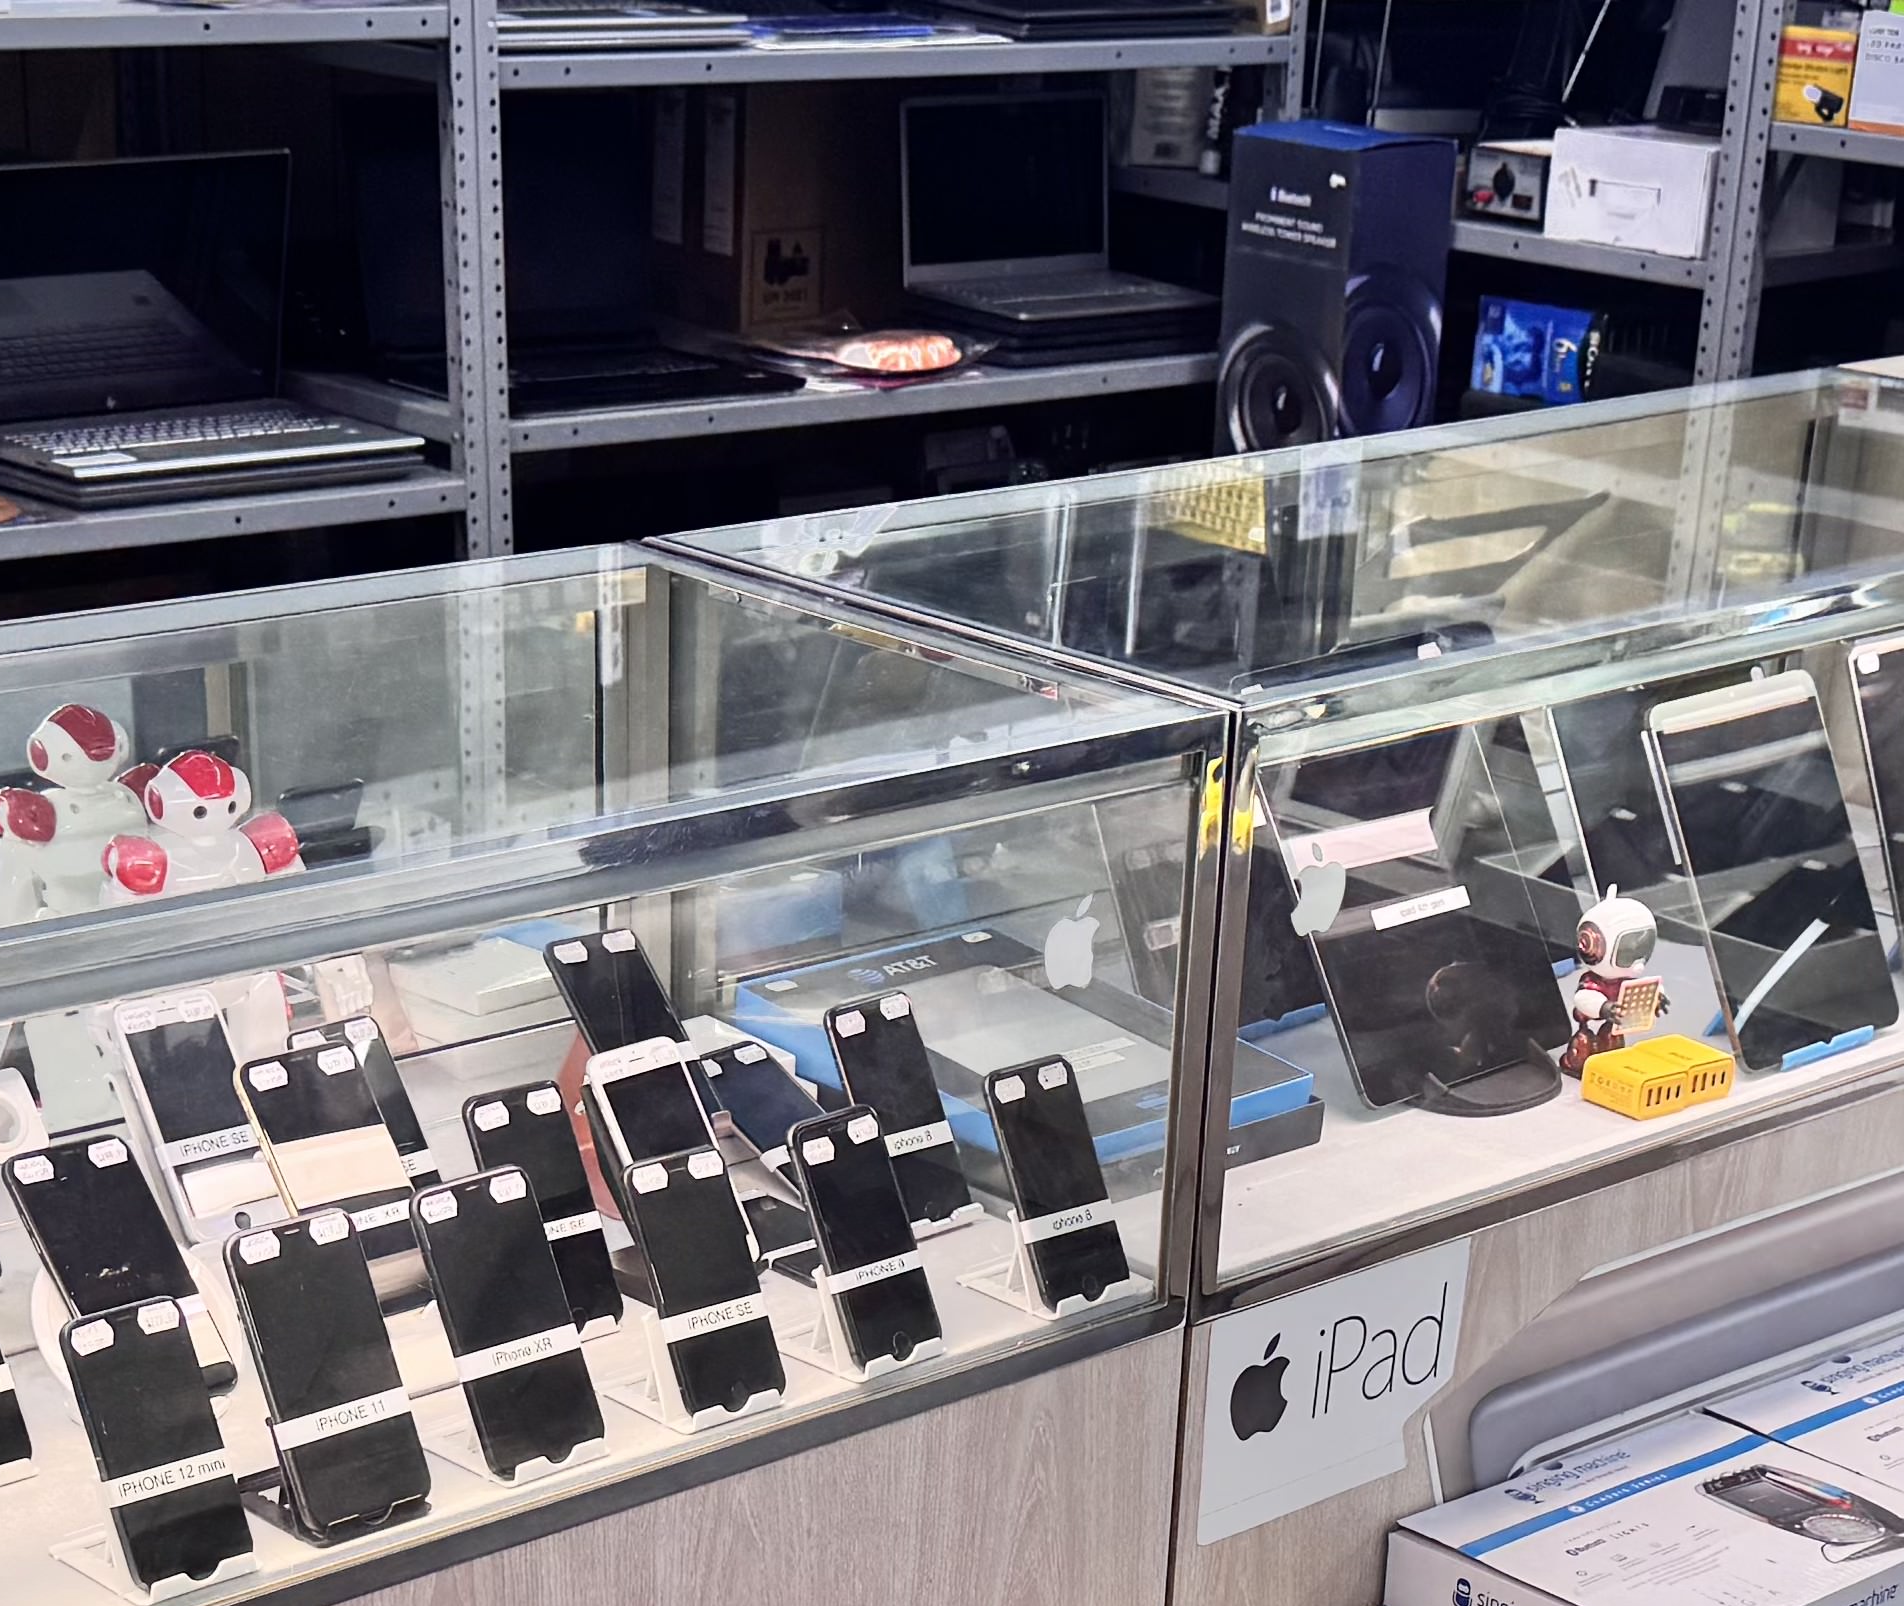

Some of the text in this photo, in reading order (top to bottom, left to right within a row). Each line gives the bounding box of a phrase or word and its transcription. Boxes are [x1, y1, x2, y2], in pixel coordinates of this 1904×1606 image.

[881, 953, 940, 978] AT&T
[180, 1130, 250, 1159] IPHONE SE
[686, 1301, 755, 1332] IPHONE SE
[533, 1336, 554, 1354] XR
[1311, 1280, 1451, 1419] iPad
[314, 1400, 386, 1433] IPHONE 11
[117, 1458, 227, 1498] IPHONE 12 mini
